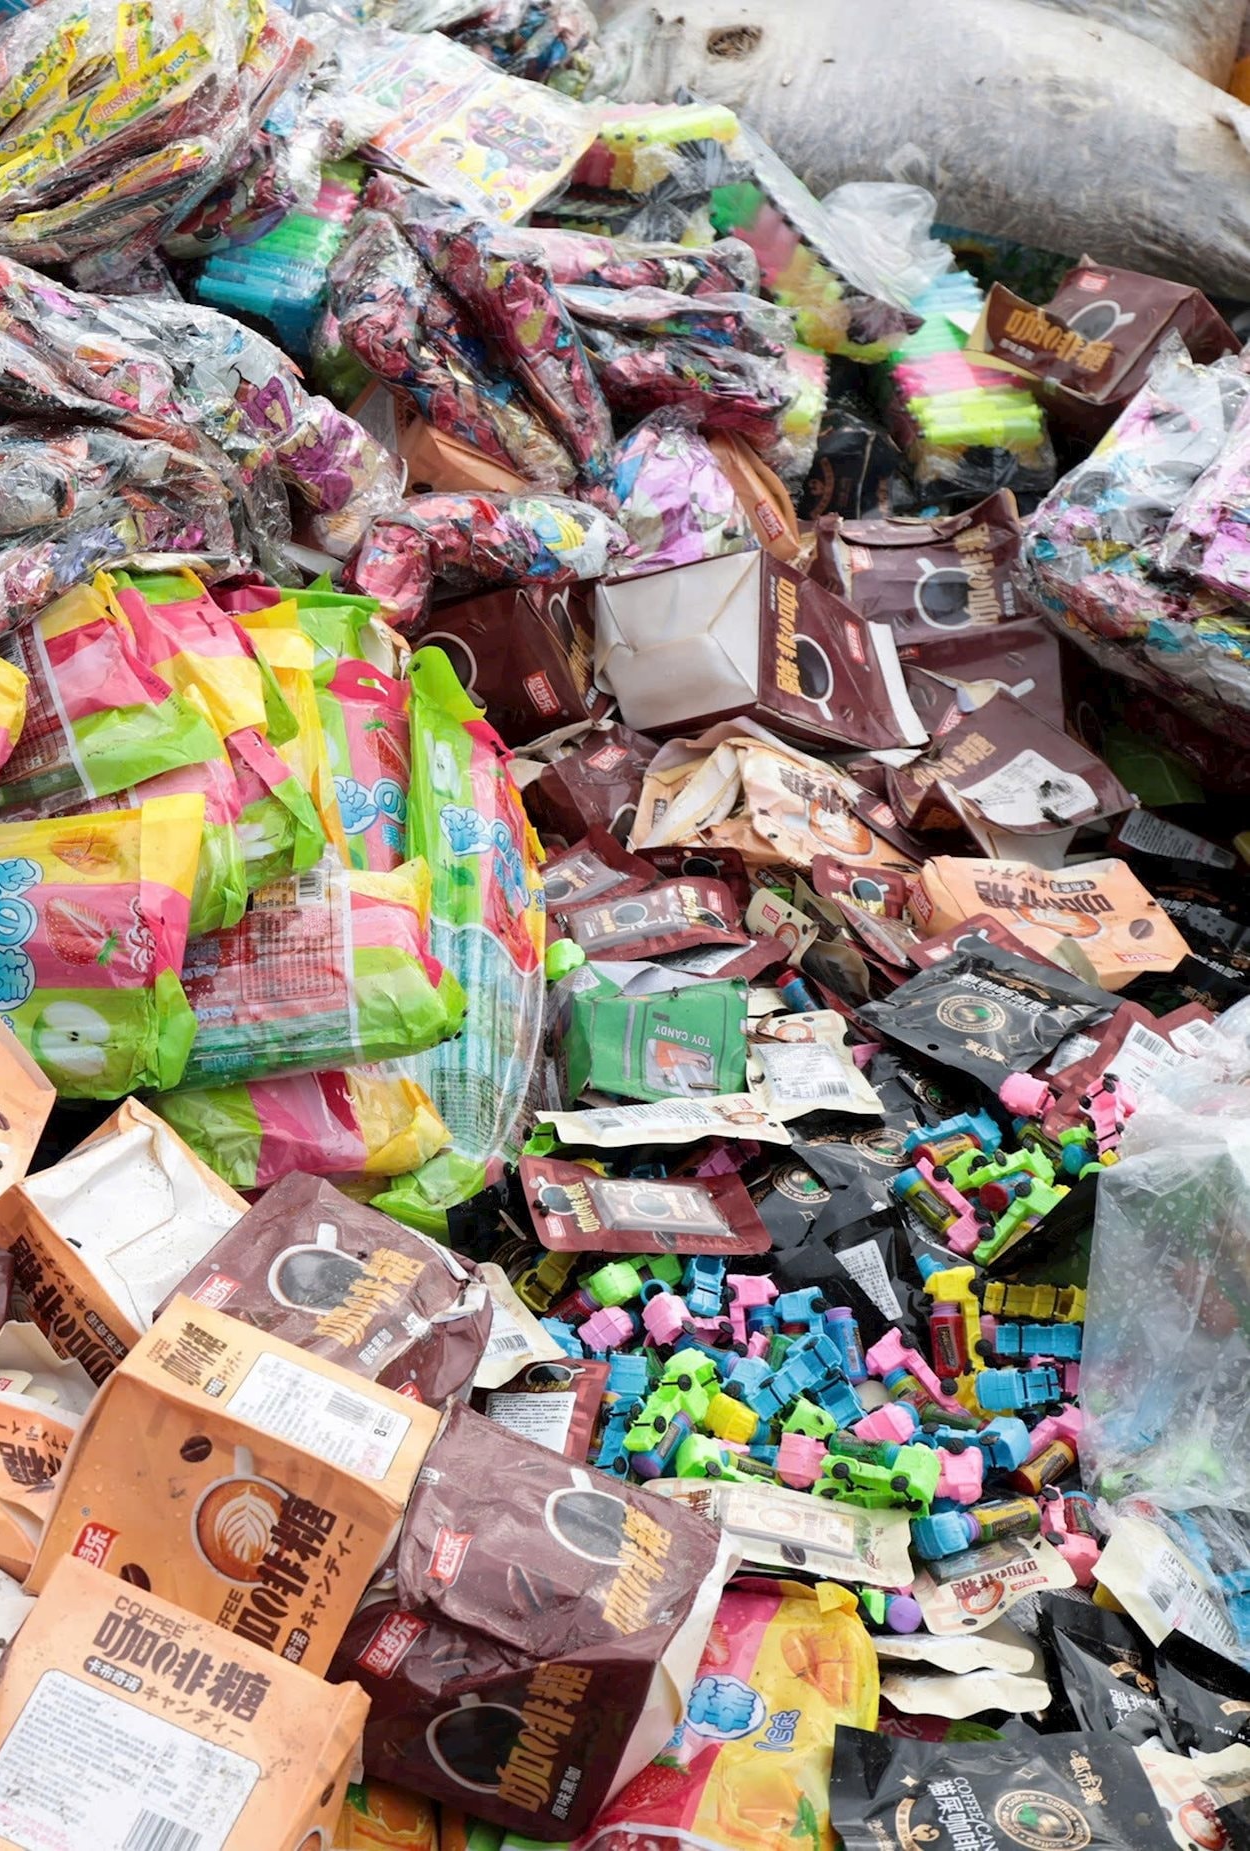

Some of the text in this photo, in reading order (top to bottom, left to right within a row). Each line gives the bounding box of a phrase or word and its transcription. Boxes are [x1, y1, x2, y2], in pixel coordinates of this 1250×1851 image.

[653, 1026, 711, 1049] TOY CANDY
[316, 1248, 426, 1347] 咖啡糖
[160, 1321, 228, 1385] 咖啡糖
[76, 1527, 114, 1566] 特乐
[299, 1523, 354, 1626] キャンディー
[603, 1506, 672, 1634] 咖啡糖
[115, 1595, 187, 1638] COFFEE
[218, 1588, 244, 1628] FFEE
[93, 1610, 271, 1723] 咖啡糖
[366, 1617, 418, 1672] 思特乐
[89, 1660, 245, 1738] 卡布奇诺 キャンディー
[495, 1664, 594, 1812] 咖啡糖
[552, 1766, 582, 1820] 原味黑咖
[955, 1777, 984, 1821] COFFEE
